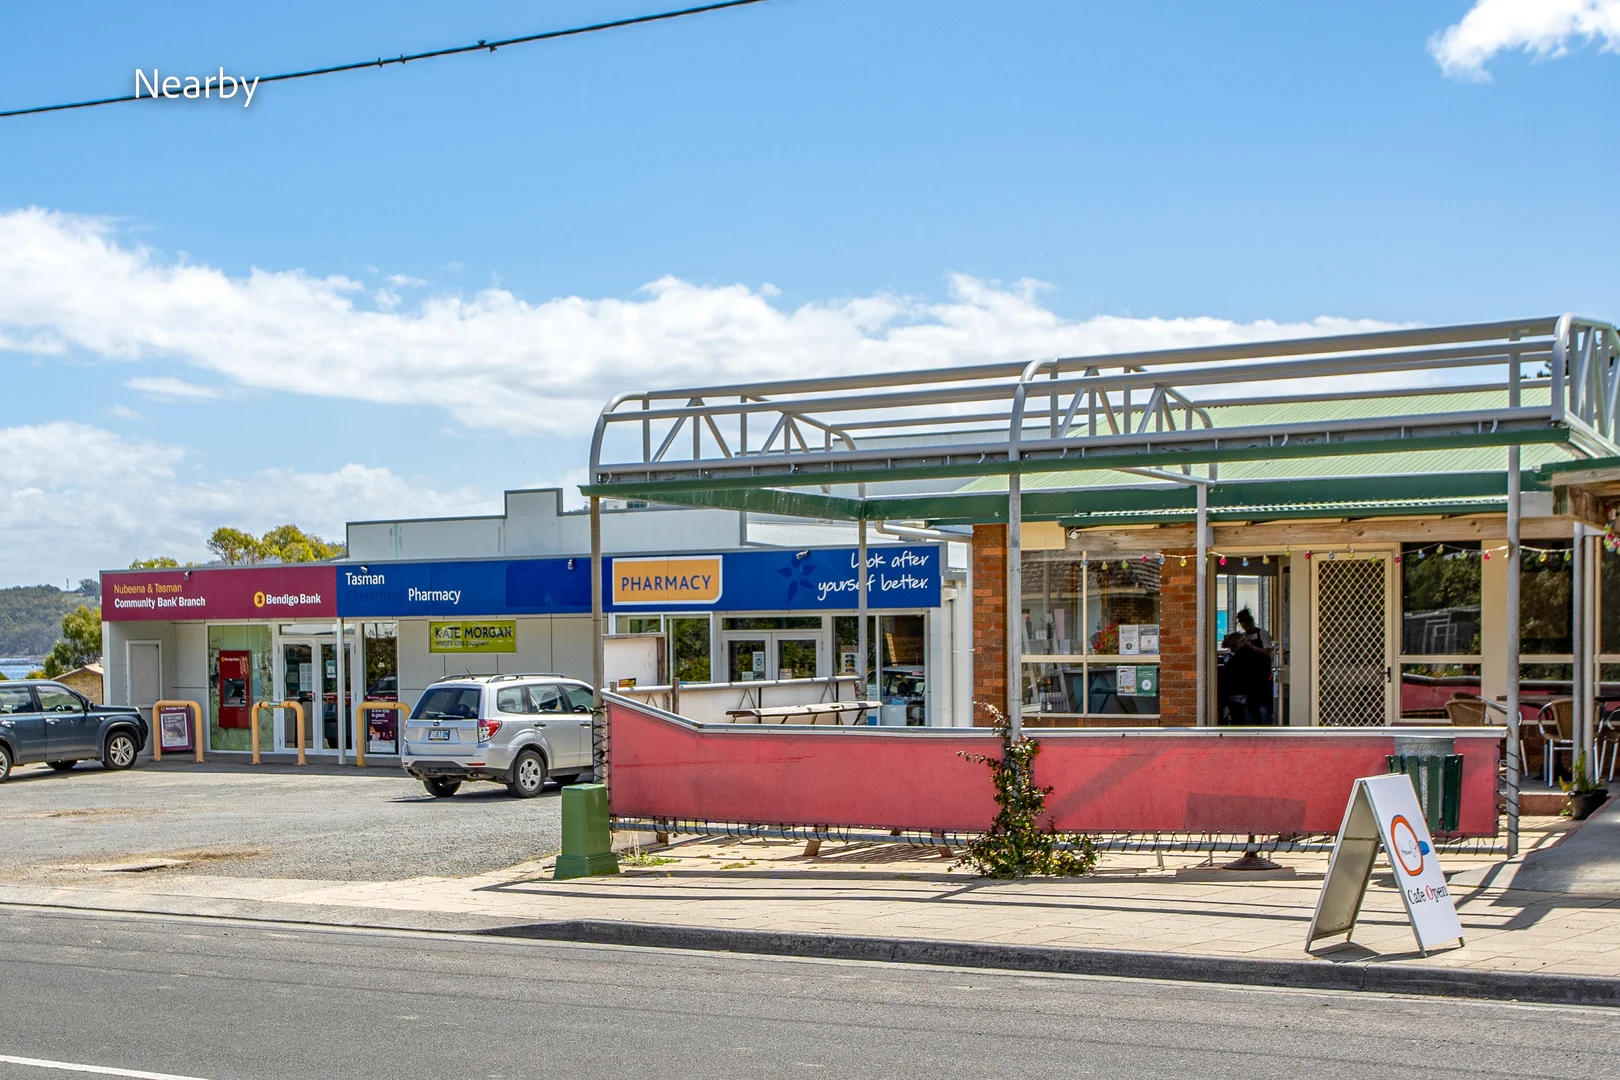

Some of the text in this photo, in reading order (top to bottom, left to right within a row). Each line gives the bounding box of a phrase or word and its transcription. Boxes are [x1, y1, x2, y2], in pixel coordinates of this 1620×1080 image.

[851, 550, 929, 569] Lok after
[345, 572, 385, 586] Tasman
[621, 574, 712, 591] PHARMACY
[113, 583, 182, 594] Nubeena & Tasman
[817, 573, 876, 601] yoursef
[114, 597, 156, 610] Community
[178, 596, 206, 607] Branch
[266, 593, 321, 607] Bendigo Bank
[408, 587, 461, 604] Pharmacy
[435, 626, 512, 639] KATE MORGAN
[1407, 885, 1449, 905] Cafe Open
